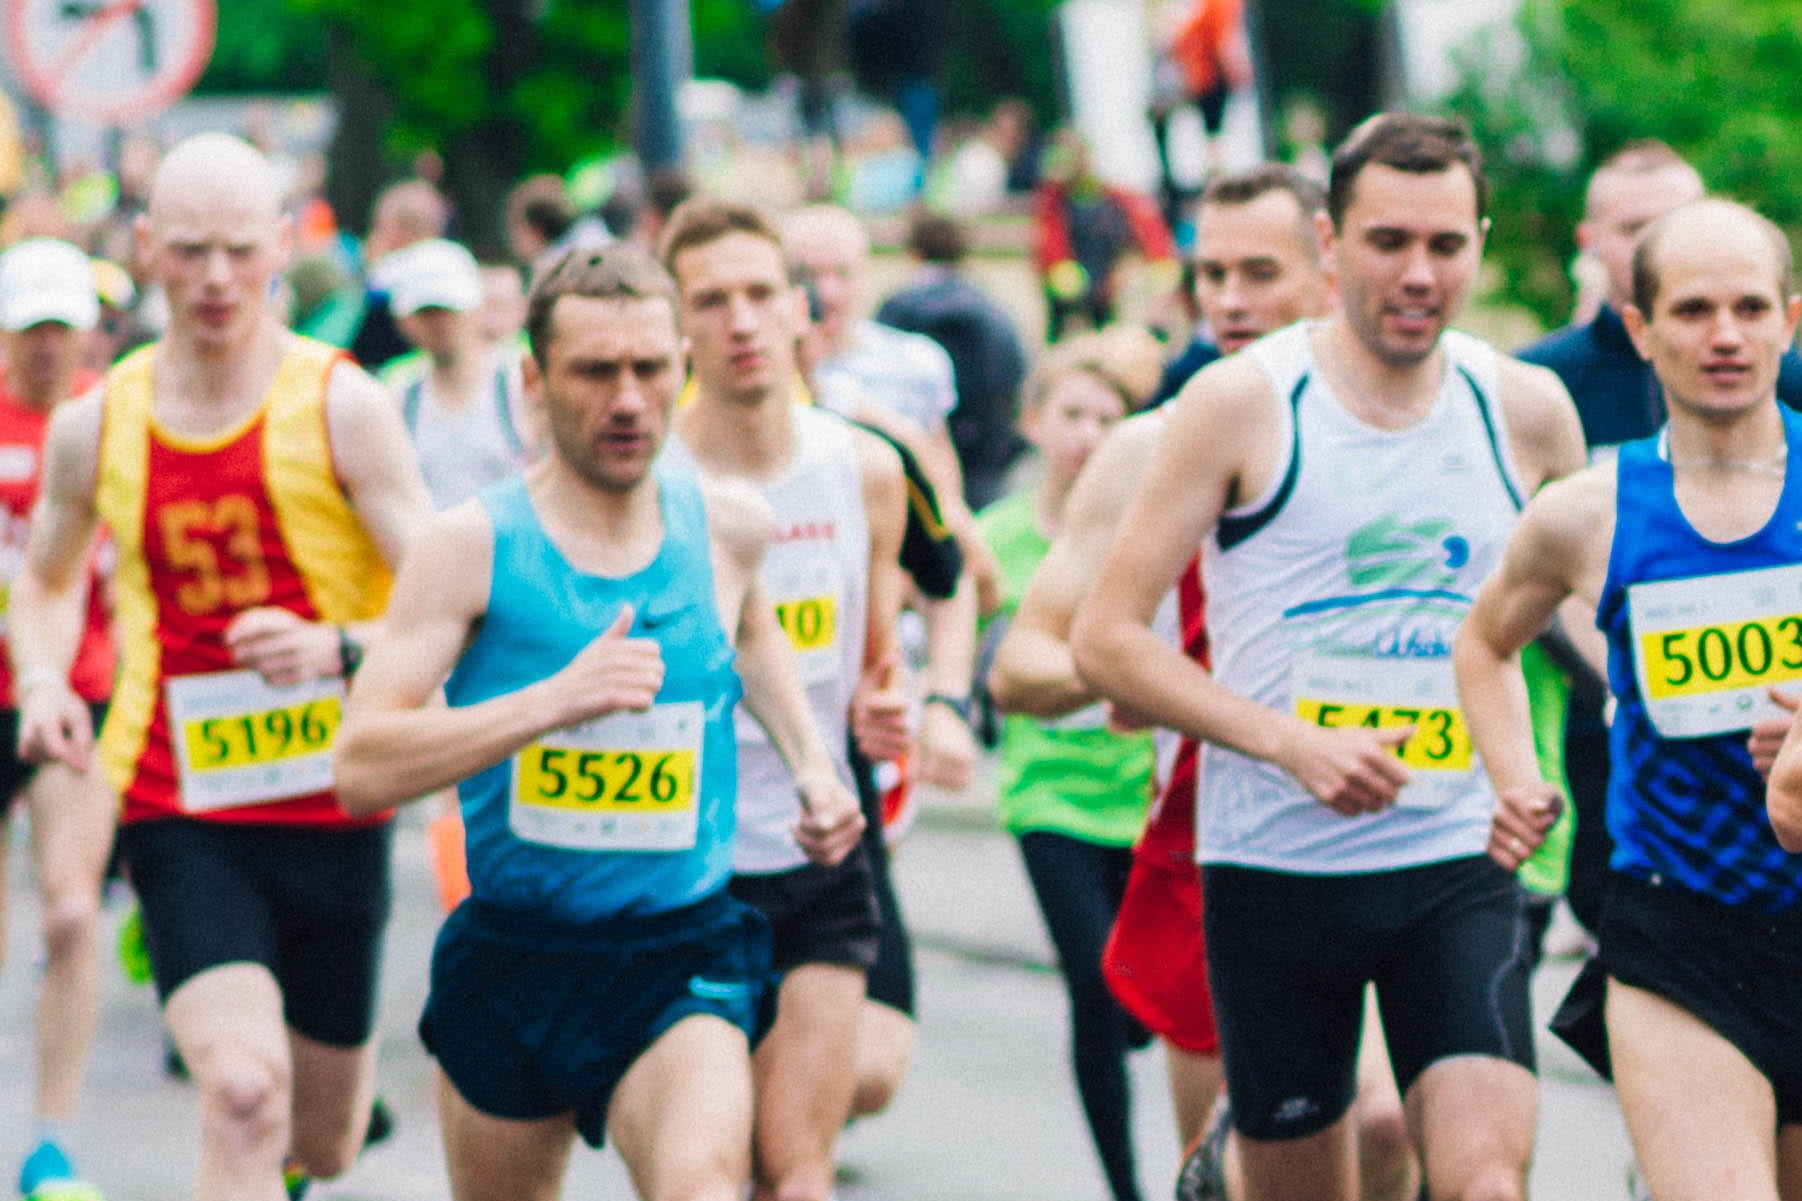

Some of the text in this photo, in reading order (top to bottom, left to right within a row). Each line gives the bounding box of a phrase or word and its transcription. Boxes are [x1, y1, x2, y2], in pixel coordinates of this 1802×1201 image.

[161, 494, 272, 614] 53
[202, 702, 327, 761] 5196
[538, 749, 677, 803] 5526
